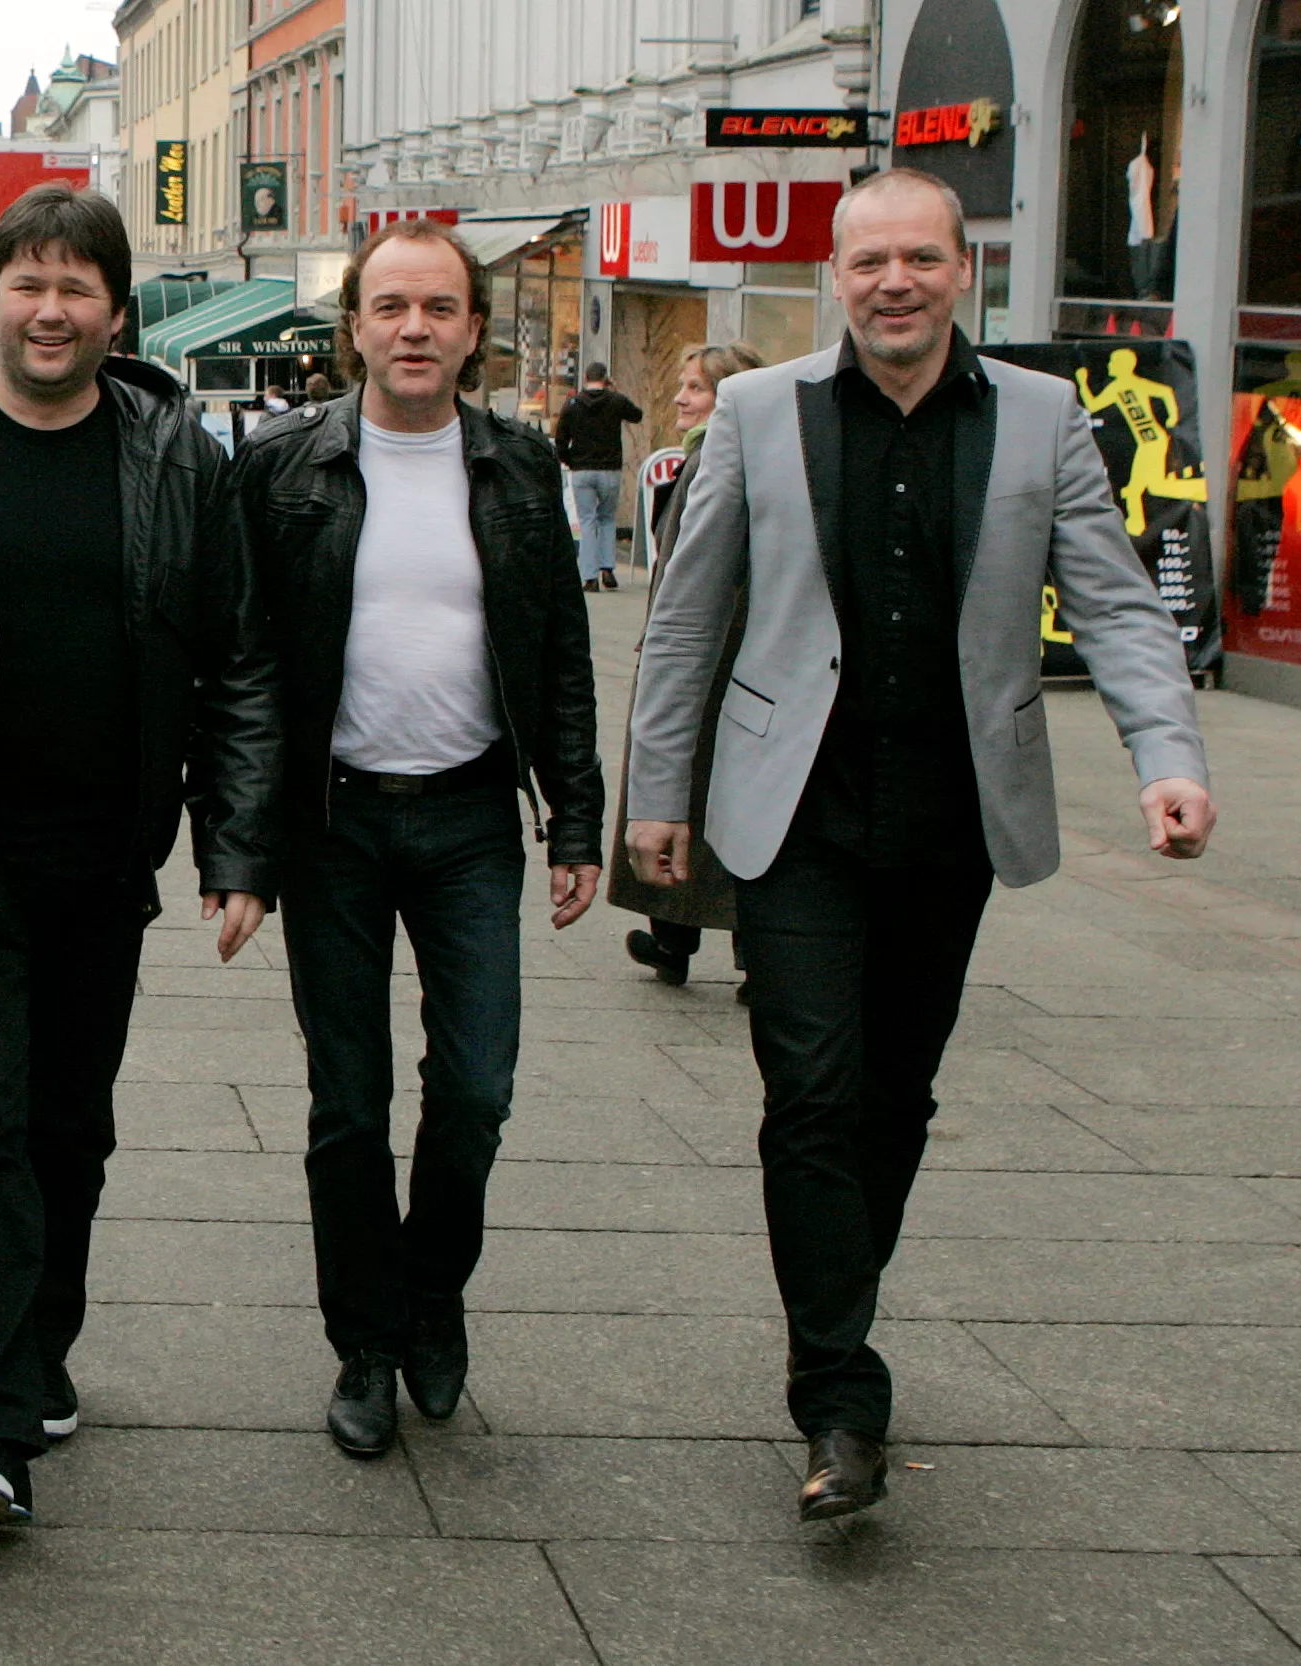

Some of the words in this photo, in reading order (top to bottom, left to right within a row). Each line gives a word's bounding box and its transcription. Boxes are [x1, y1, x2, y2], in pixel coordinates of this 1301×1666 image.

[720, 116, 829, 135] BLEND
[896, 103, 972, 147] BLEND
[712, 181, 791, 249] W
[218, 340, 242, 354] SIR
[252, 338, 332, 353] WINSTON'S
[1118, 389, 1159, 442] sale
